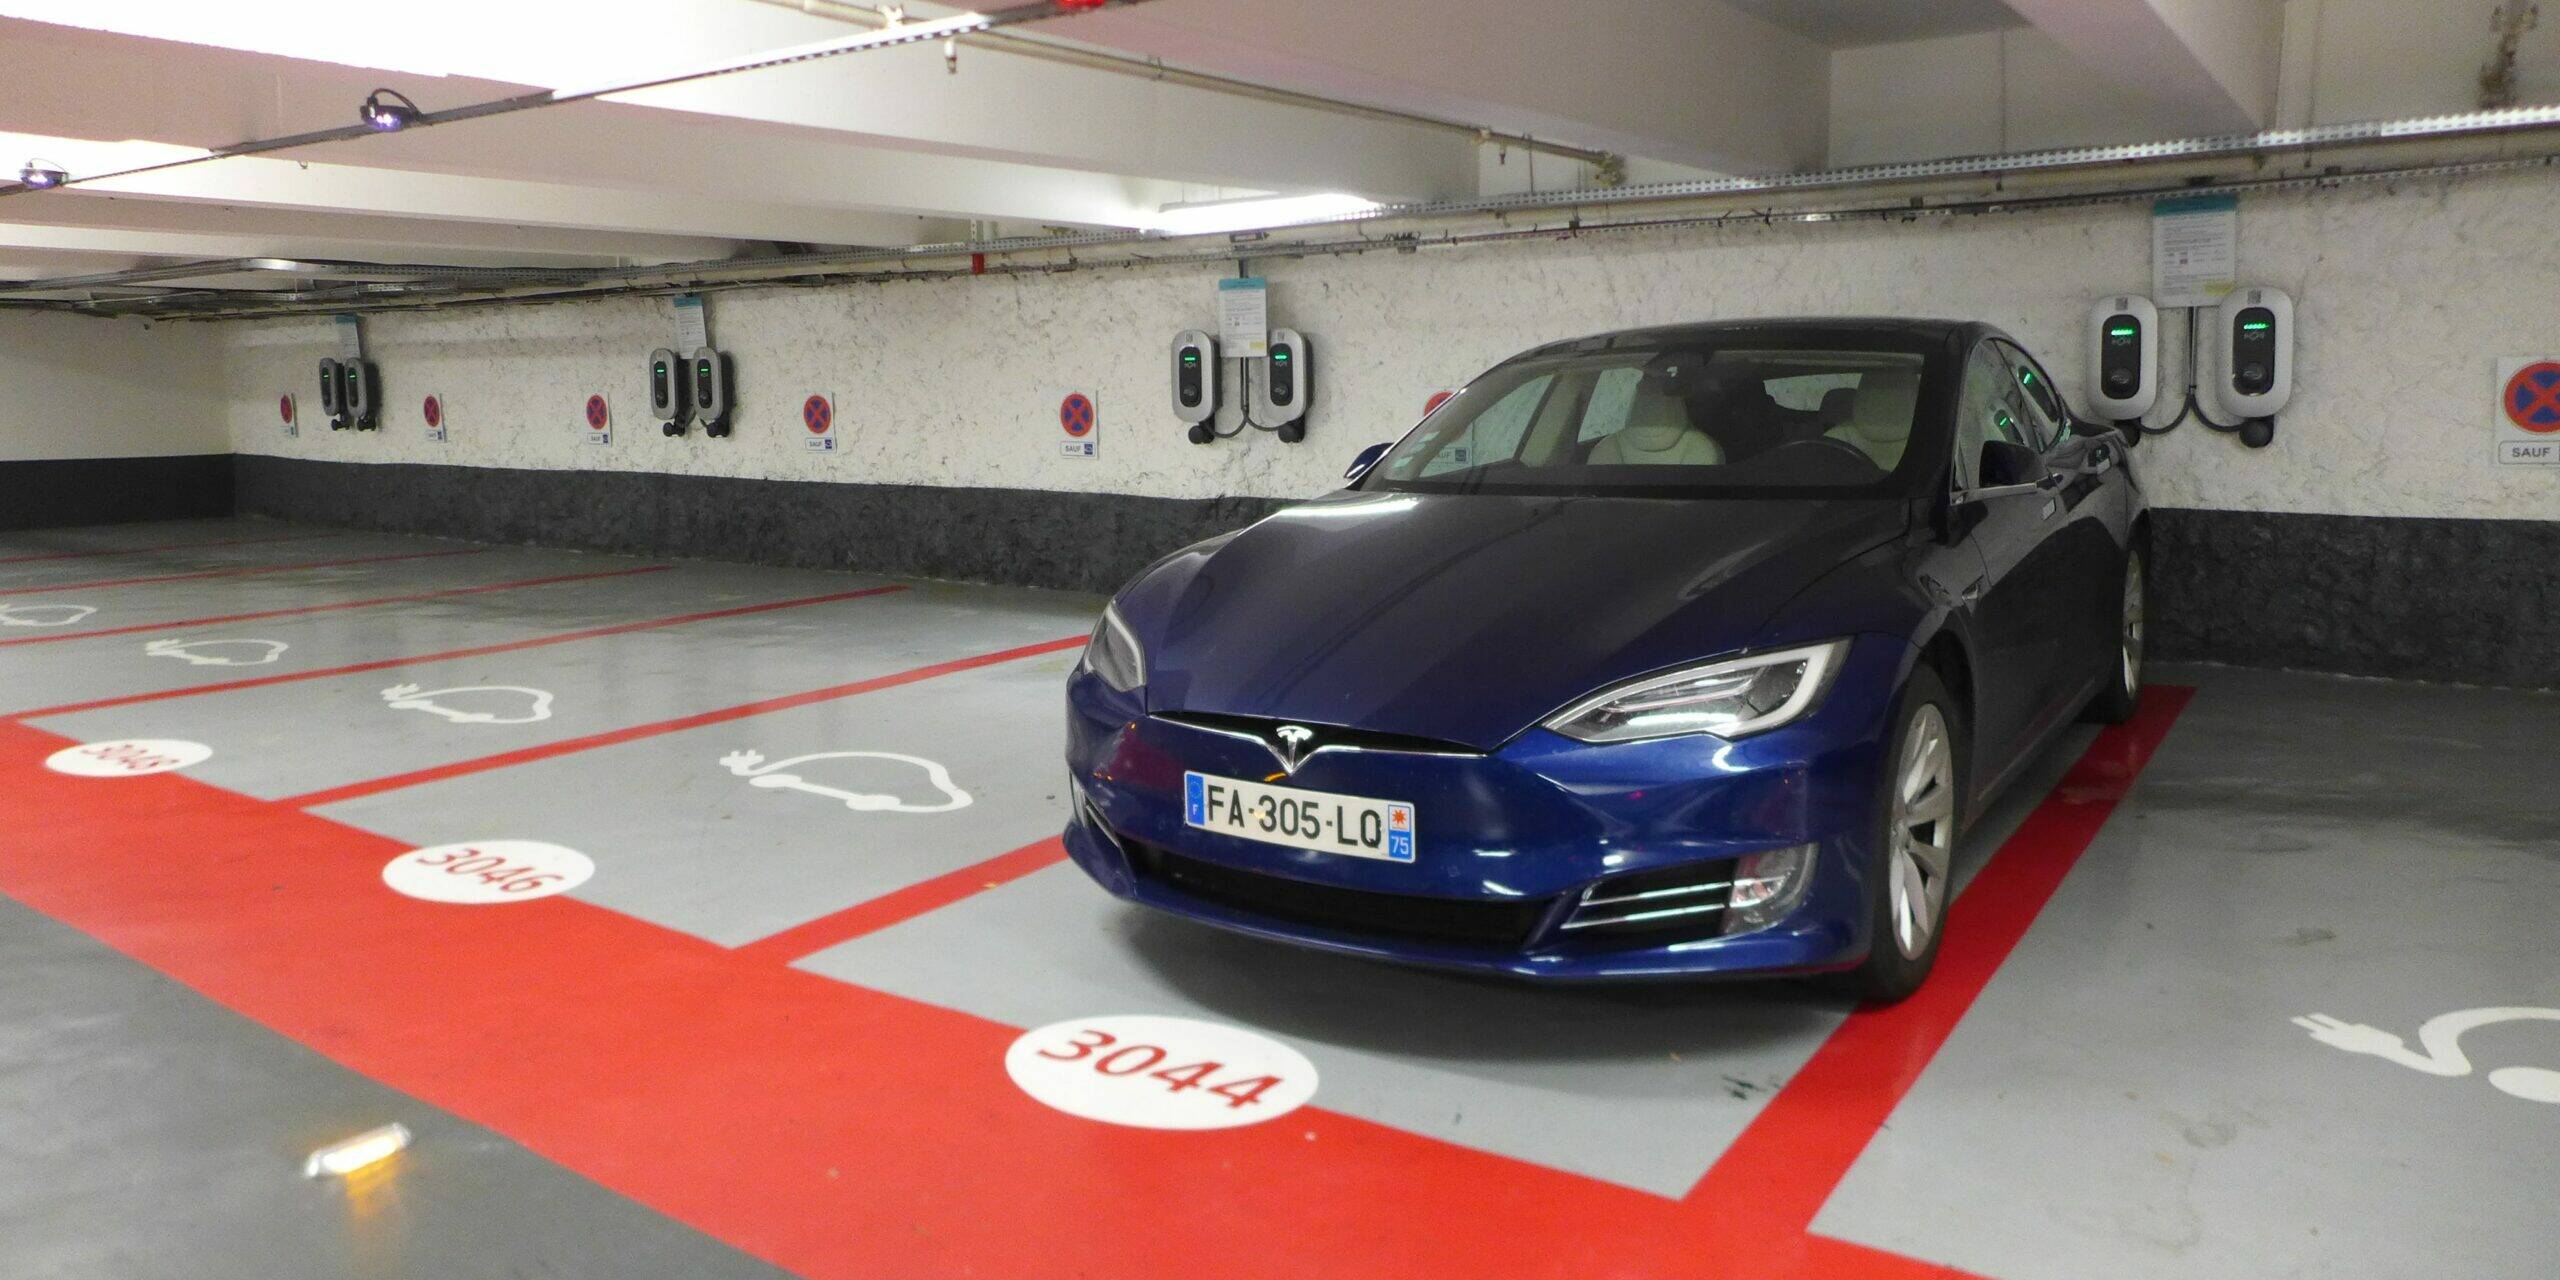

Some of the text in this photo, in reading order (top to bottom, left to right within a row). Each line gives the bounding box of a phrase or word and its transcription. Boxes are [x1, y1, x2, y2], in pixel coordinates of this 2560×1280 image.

[2512, 447, 2551, 457] SAUF
[1191, 804, 1199, 816] F
[1391, 835, 1410, 855] 75
[415, 848, 564, 893] 3046
[1036, 1029, 1284, 1109] 3044
